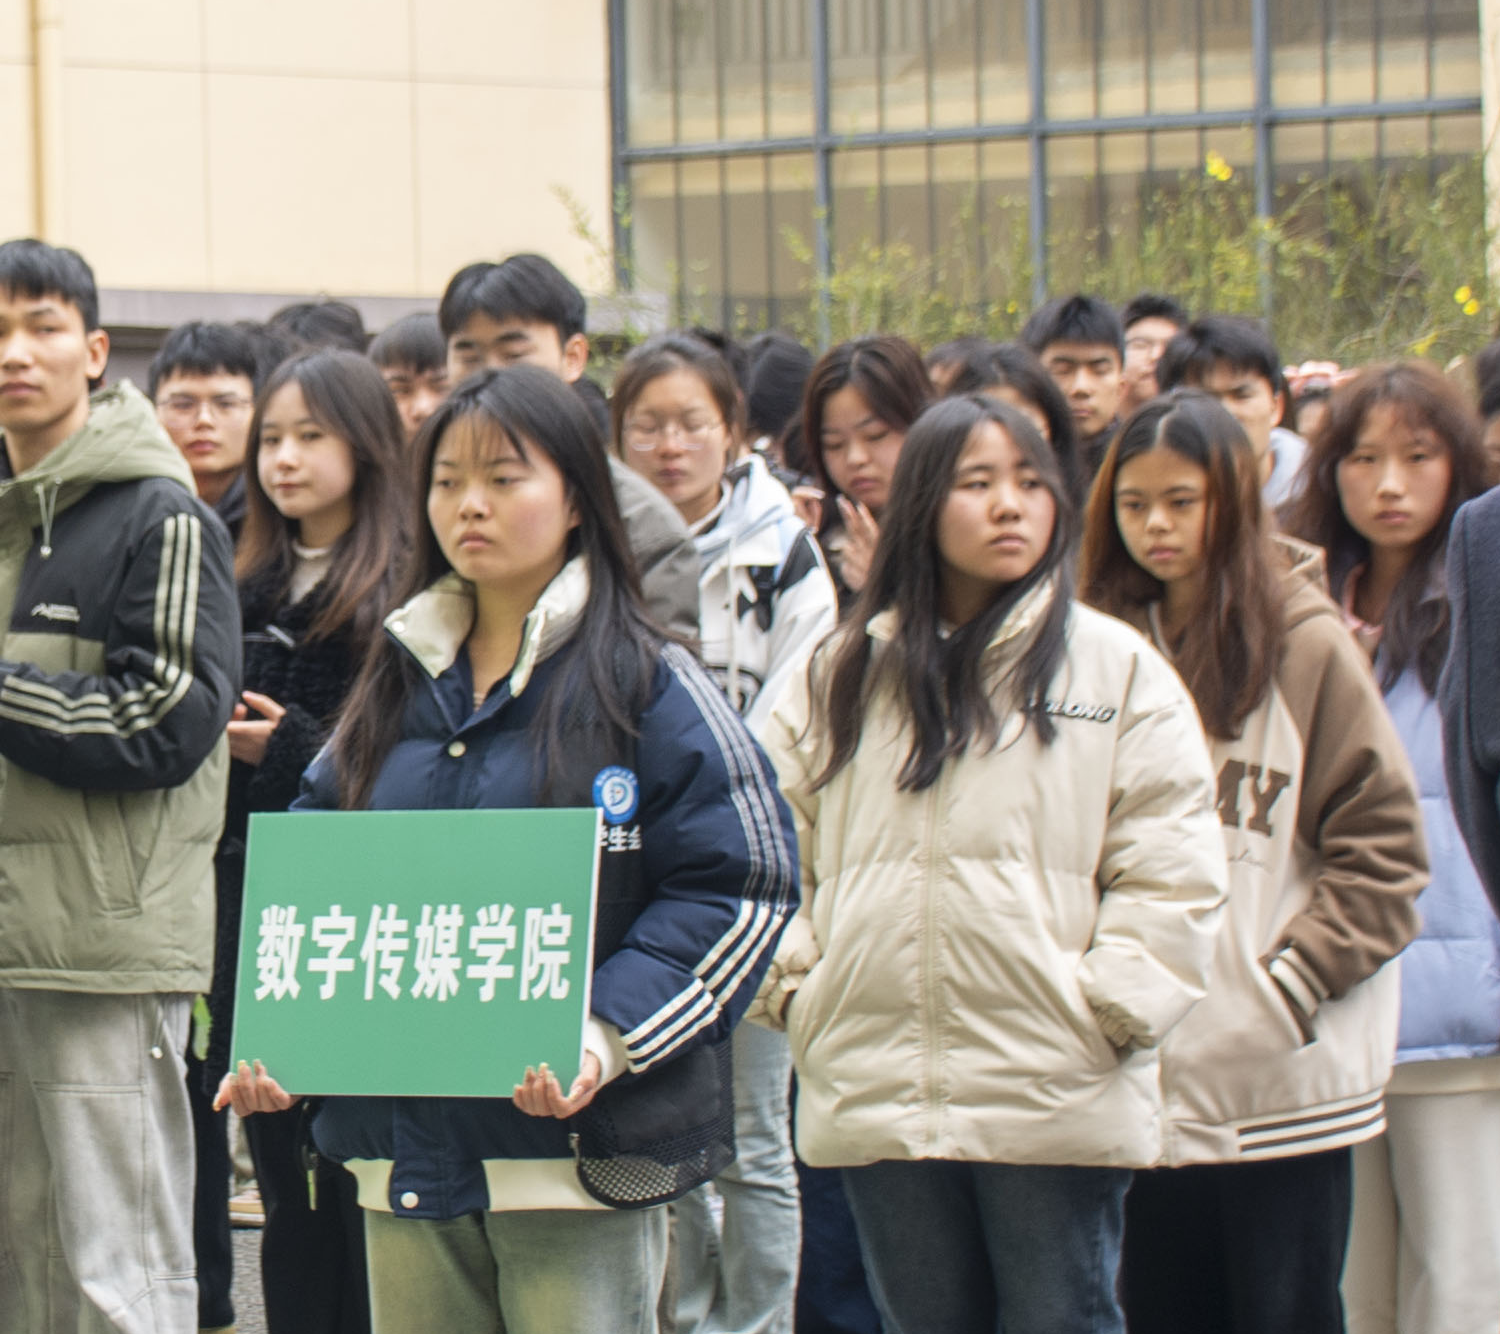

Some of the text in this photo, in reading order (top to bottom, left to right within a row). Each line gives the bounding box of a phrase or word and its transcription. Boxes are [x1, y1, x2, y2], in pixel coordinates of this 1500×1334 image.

[254, 901, 573, 1003] 数字传媒学院
